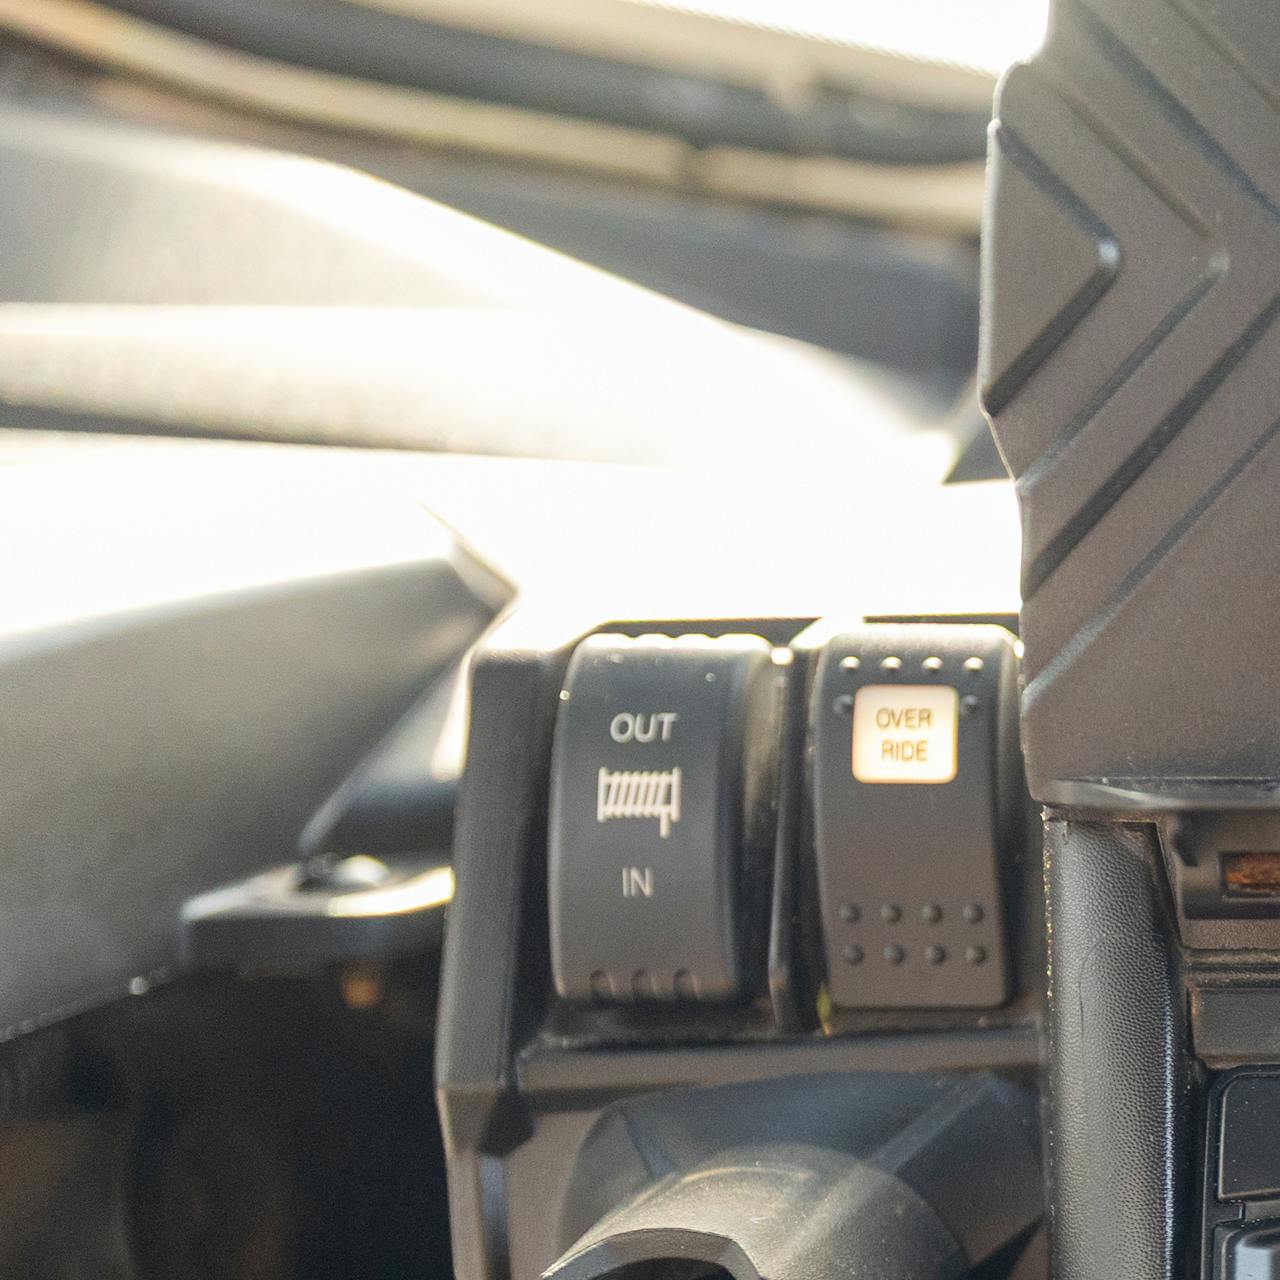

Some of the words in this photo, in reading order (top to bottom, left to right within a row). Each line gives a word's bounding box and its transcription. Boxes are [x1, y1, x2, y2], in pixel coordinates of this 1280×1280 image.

[610, 712, 678, 743] OUT
[876, 707, 932, 729] OVER
[881, 741, 928, 763] RIDE
[621, 867, 654, 898] IN
